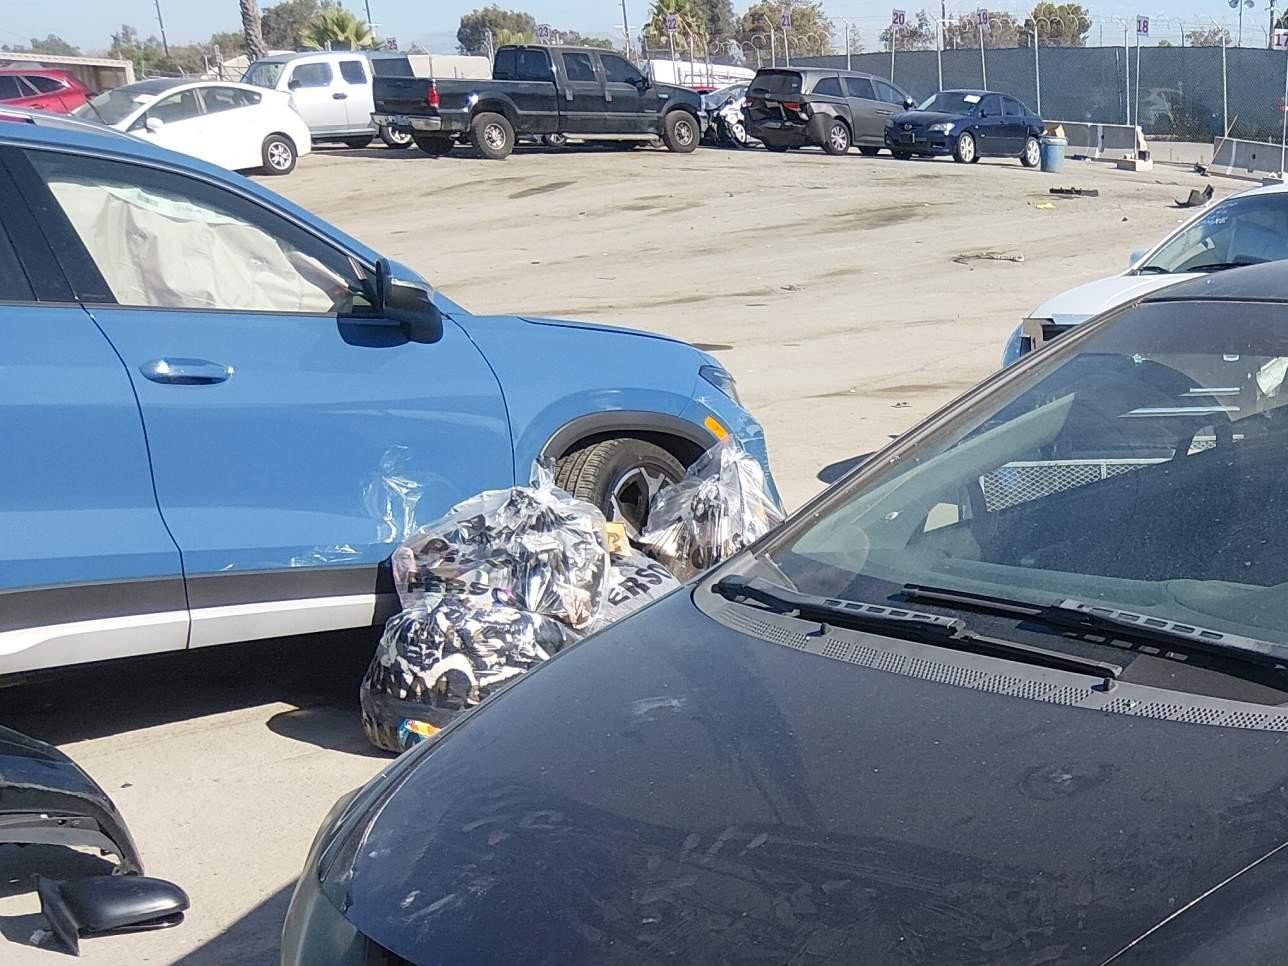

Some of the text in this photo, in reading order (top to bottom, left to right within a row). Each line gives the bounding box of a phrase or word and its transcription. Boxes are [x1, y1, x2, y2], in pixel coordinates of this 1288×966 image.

[781, 14, 791, 27] 21
[892, 12, 905, 26] 20
[976, 12, 988, 25] 19
[1136, 19, 1149, 34] 18
